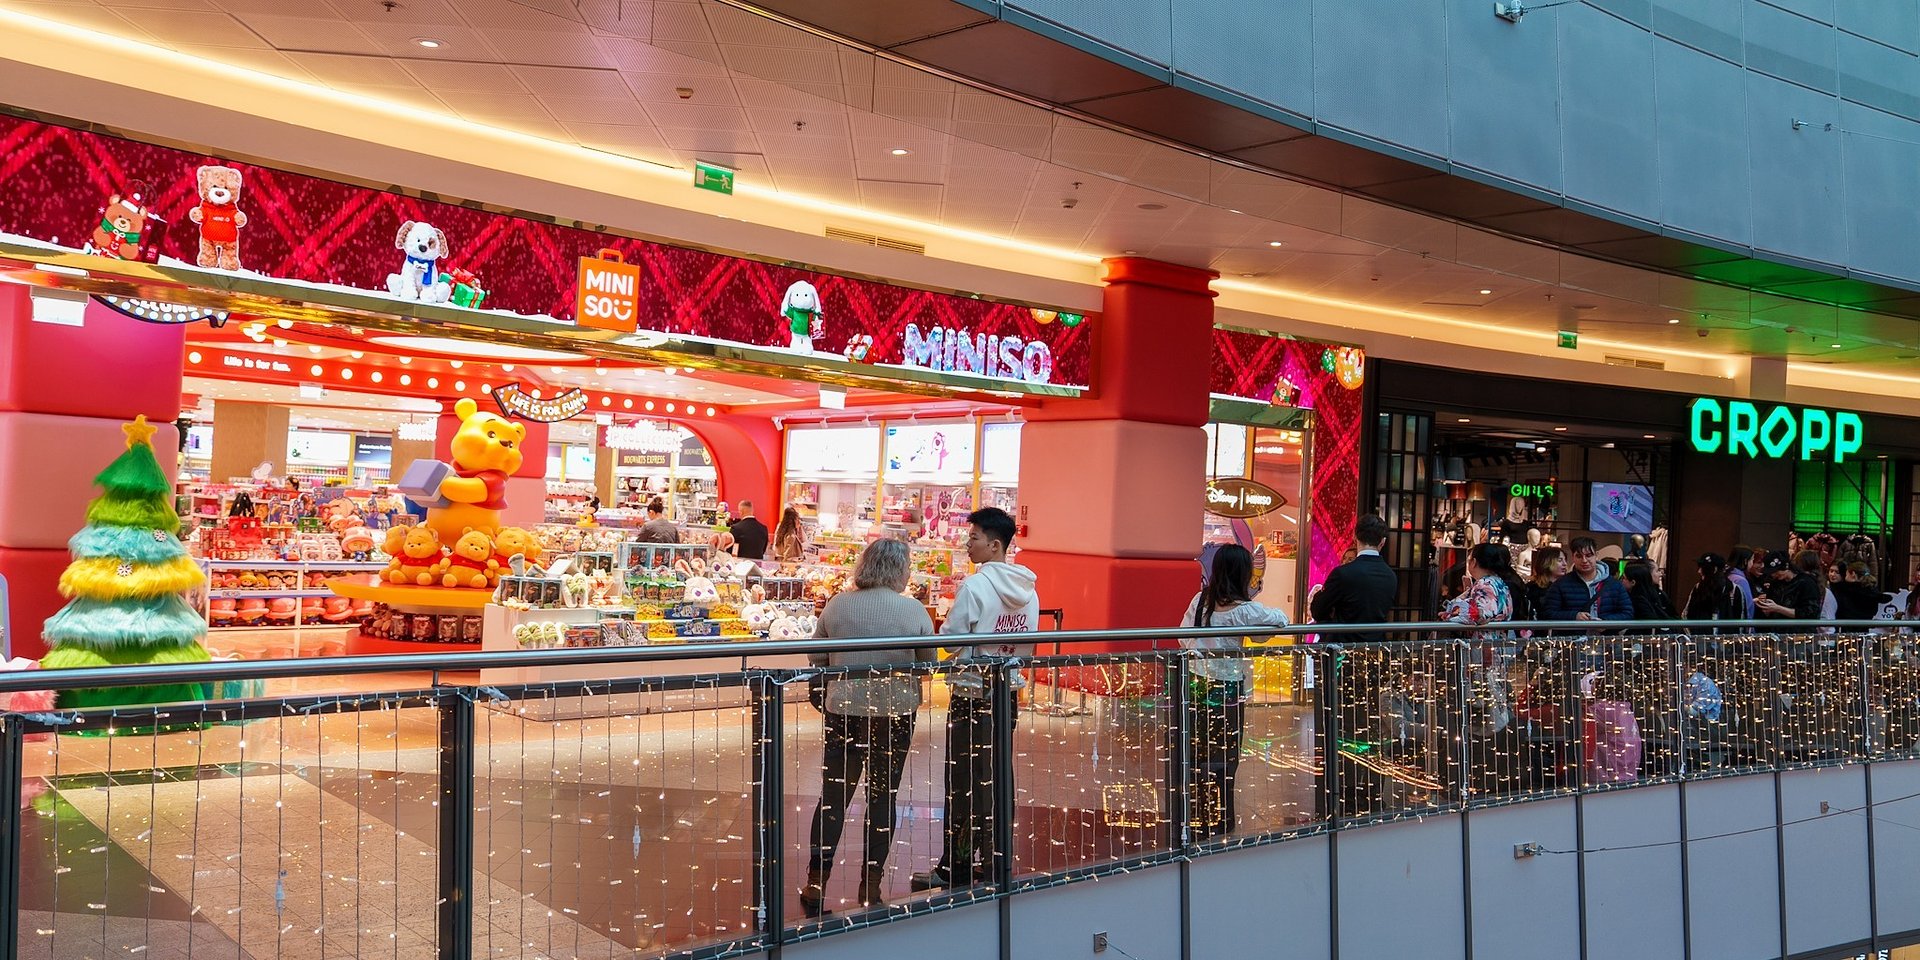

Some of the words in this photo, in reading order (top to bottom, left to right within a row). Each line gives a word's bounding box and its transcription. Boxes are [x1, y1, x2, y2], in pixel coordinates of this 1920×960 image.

[586, 269, 634, 296] MINI
[902, 323, 1051, 384] MINISO
[510, 394, 530, 411] LIFE
[530, 404, 540, 414] IS
[541, 406, 561, 416] FOR
[1691, 397, 1863, 463] CROPP
[1206, 487, 1238, 508] Disney
[995, 614, 1027, 630] MINISO
